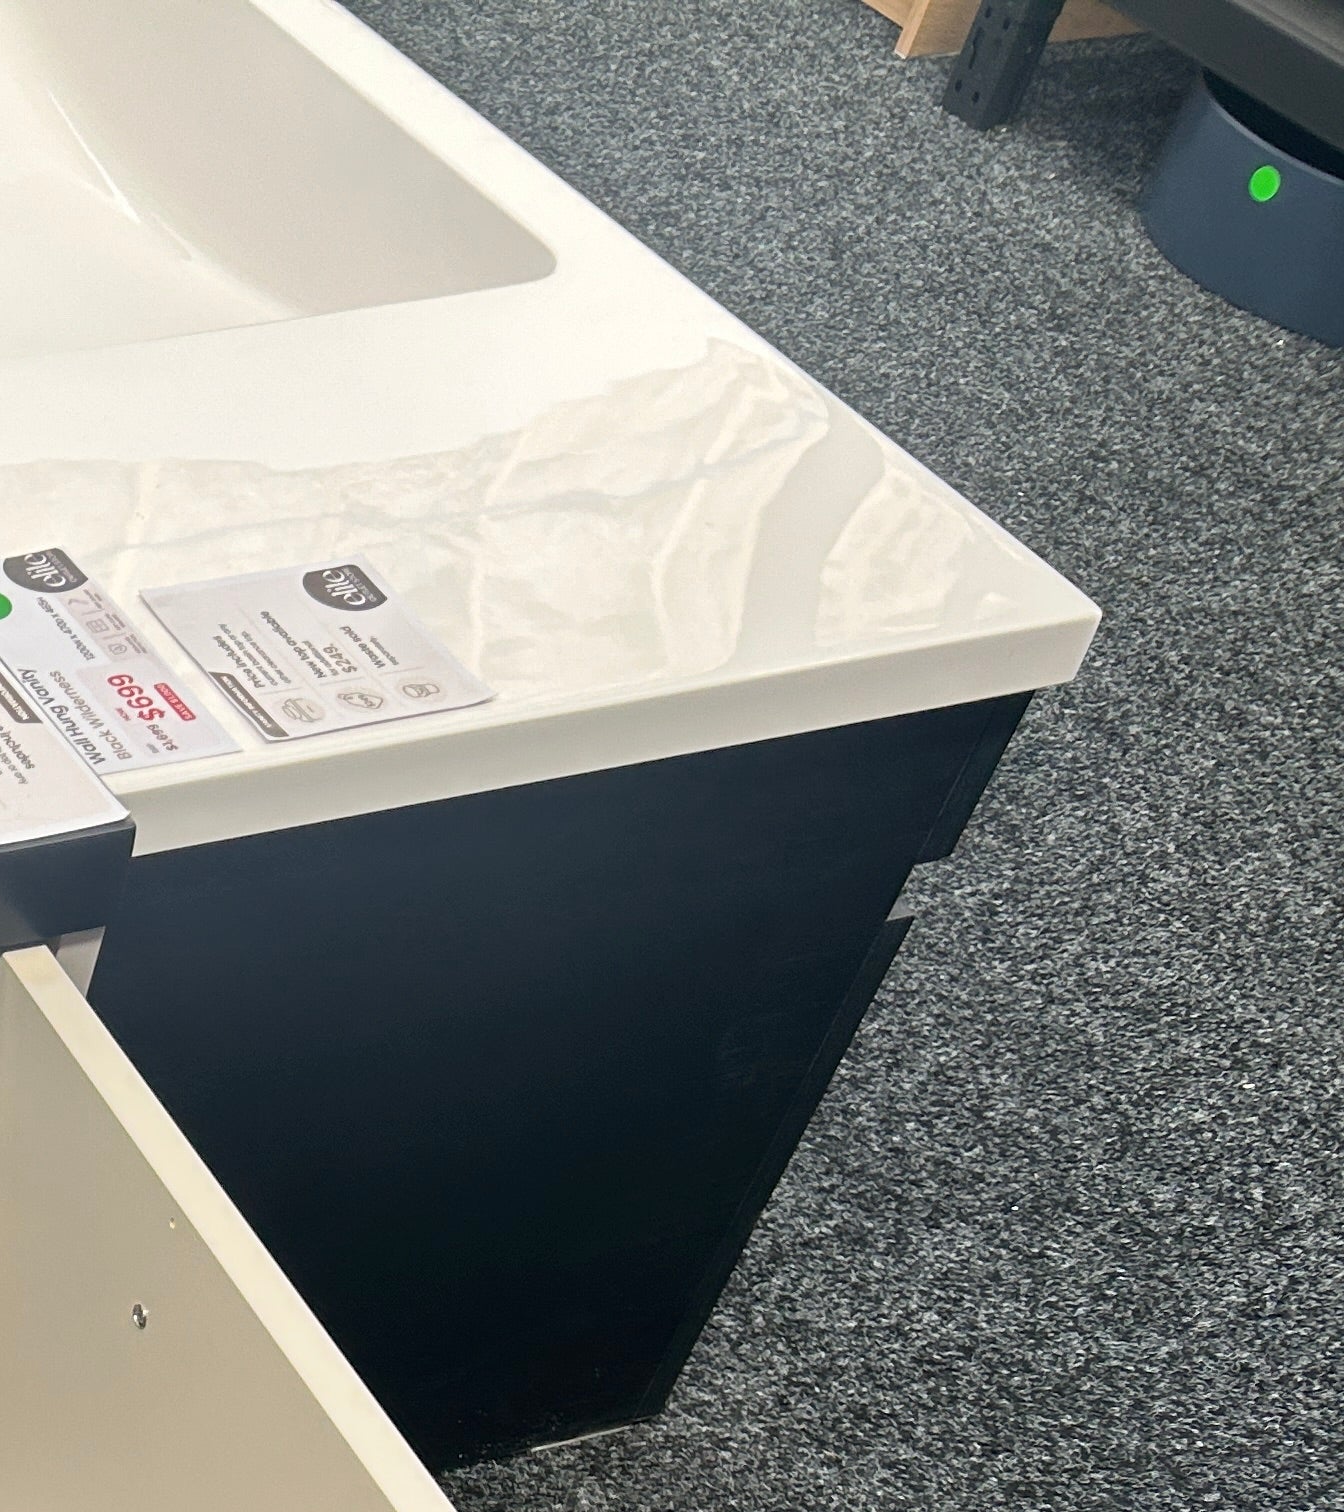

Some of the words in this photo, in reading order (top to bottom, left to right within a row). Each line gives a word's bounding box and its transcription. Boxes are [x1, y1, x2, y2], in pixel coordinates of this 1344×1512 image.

[23, 553, 66, 587] elite
[322, 570, 366, 605] elite
[339, 626, 362, 642] sold
[213, 635, 247, 668] includes
[293, 646, 310, 660] top
[323, 643, 358, 673] $249.
[358, 643, 386, 668] Waste
[243, 668, 265, 688] Price
[306, 661, 327, 678] New
[17, 669, 55, 704] Vanity
[49, 671, 104, 729] Wilderness
[107, 674, 165, 721] $699
[50, 705, 84, 737] Hung
[0, 731, 35, 769] includes
[73, 738, 106, 764] Wall
[99, 729, 132, 760] Black
